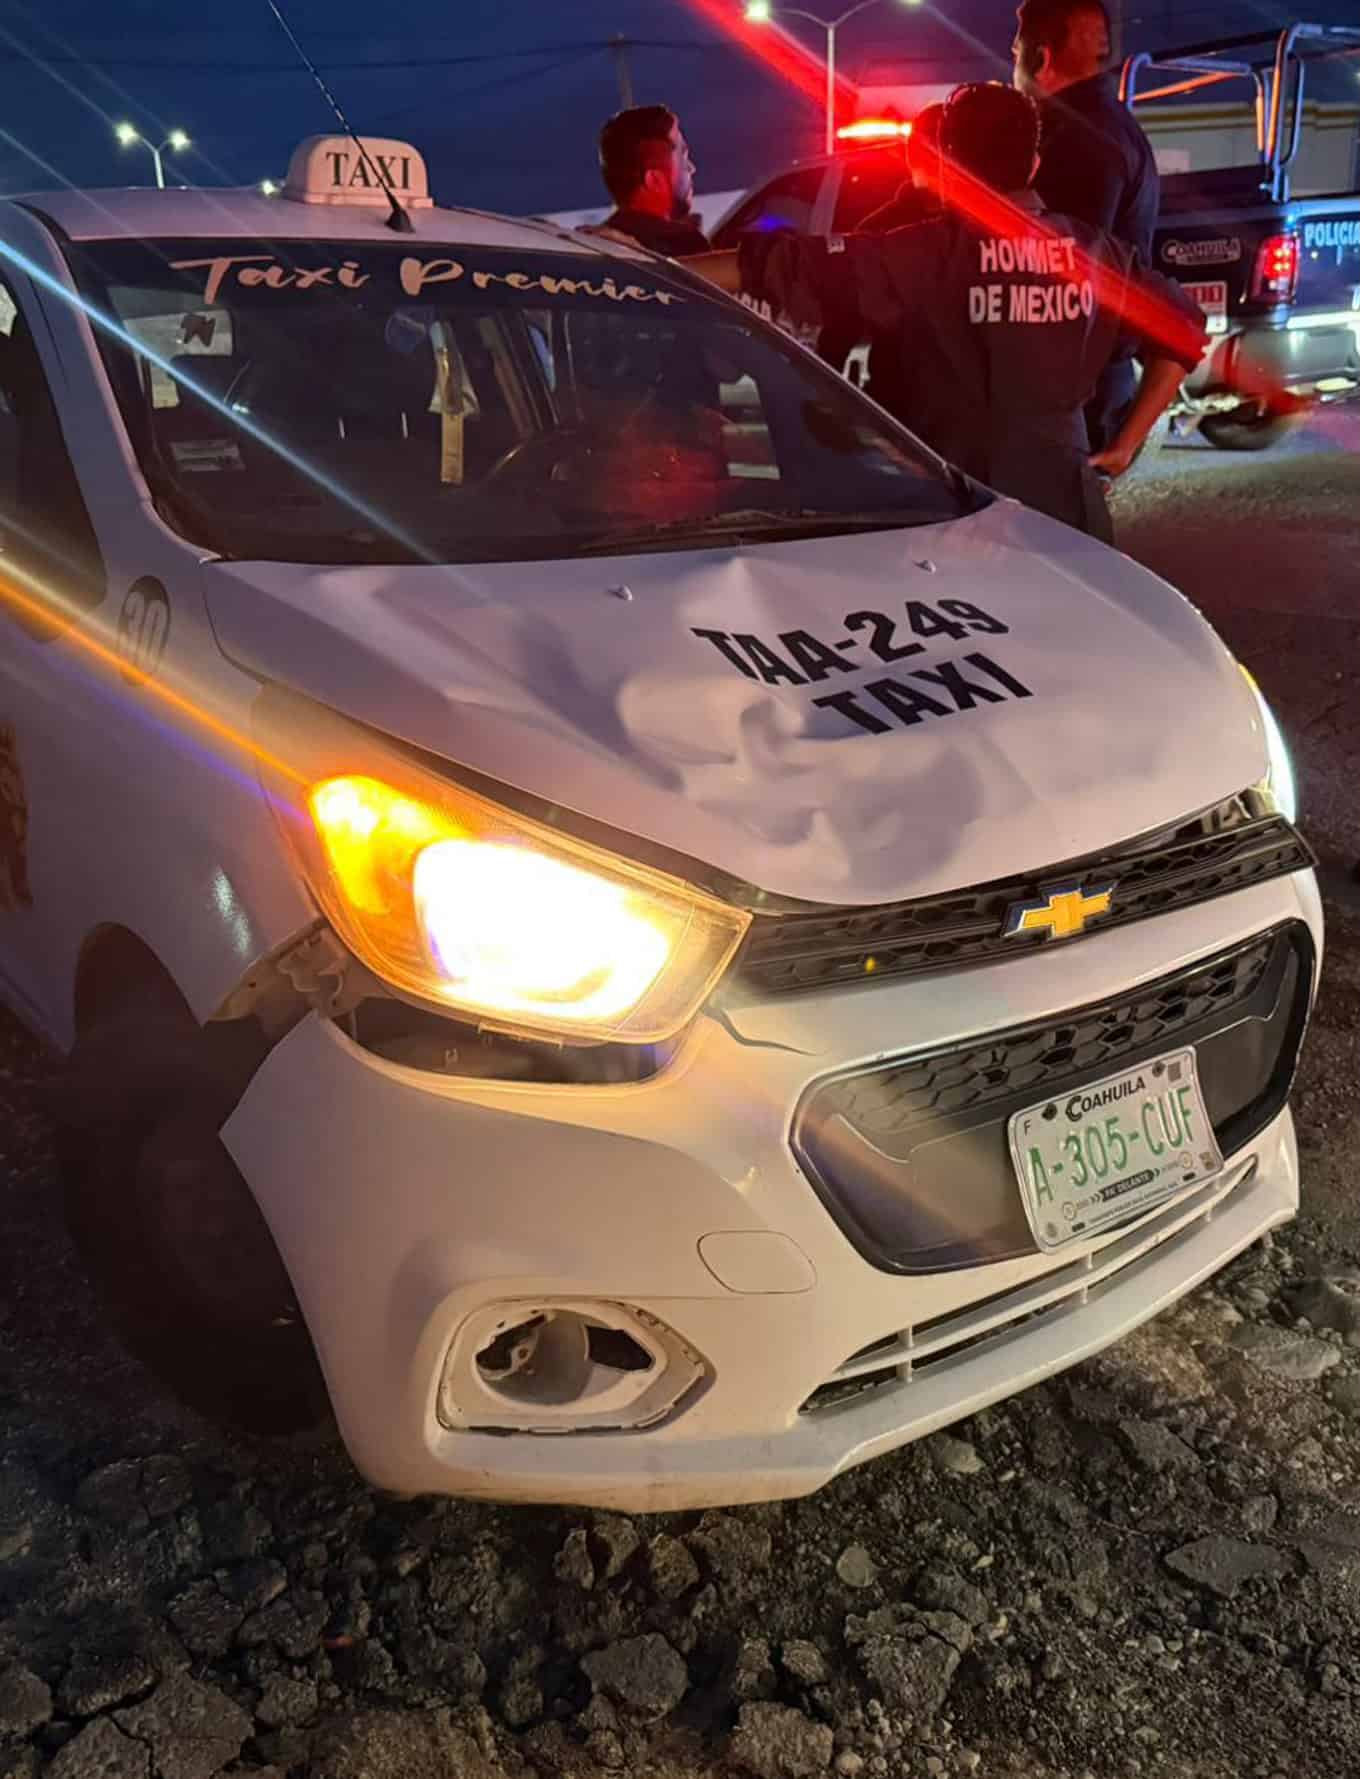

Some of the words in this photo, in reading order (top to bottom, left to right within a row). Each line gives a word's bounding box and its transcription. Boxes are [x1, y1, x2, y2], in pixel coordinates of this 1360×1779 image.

[326, 151, 411, 190] TAXI
[979, 236, 1076, 274] HOWMET
[1304, 221, 1360, 248] POLICIA
[168, 255, 371, 304] Taxi
[400, 256, 690, 305] Premier
[969, 285, 1003, 323] DE
[1008, 280, 1093, 322] MEXICO
[690, 599, 1009, 685] TAA-249
[811, 652, 1034, 735] TAXI
[1065, 1076, 1146, 1122] COAHUILA
[1028, 1086, 1193, 1209] A-305-CUF
